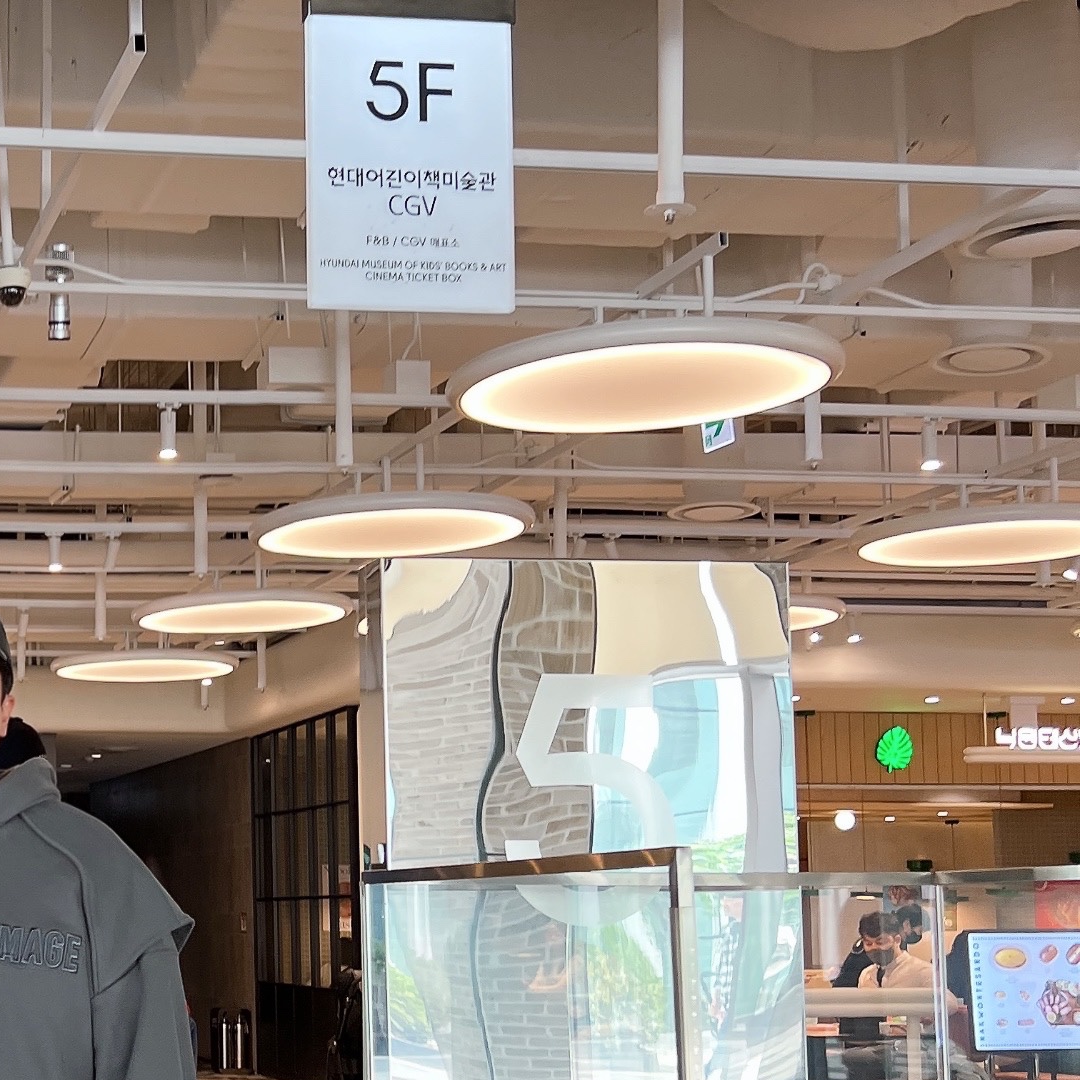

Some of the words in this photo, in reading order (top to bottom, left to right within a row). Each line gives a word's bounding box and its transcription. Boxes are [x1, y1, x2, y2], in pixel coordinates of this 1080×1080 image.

[366, 60, 455, 122] 5F
[388, 195, 438, 217] CGV
[366, 235, 390, 246] F&B
[401, 236, 427, 247] CGV
[320, 258, 360, 269] HYUNDAI
[362, 259, 403, 270] MUSEUM
[405, 260, 419, 269] OF
[445, 261, 478, 272] BOOKS
[480, 262, 487, 271] &
[489, 262, 506, 272] ART
[365, 271, 404, 282] CINEMA
[406, 272, 439, 283] TICKET
[441, 273, 462, 283] BOX
